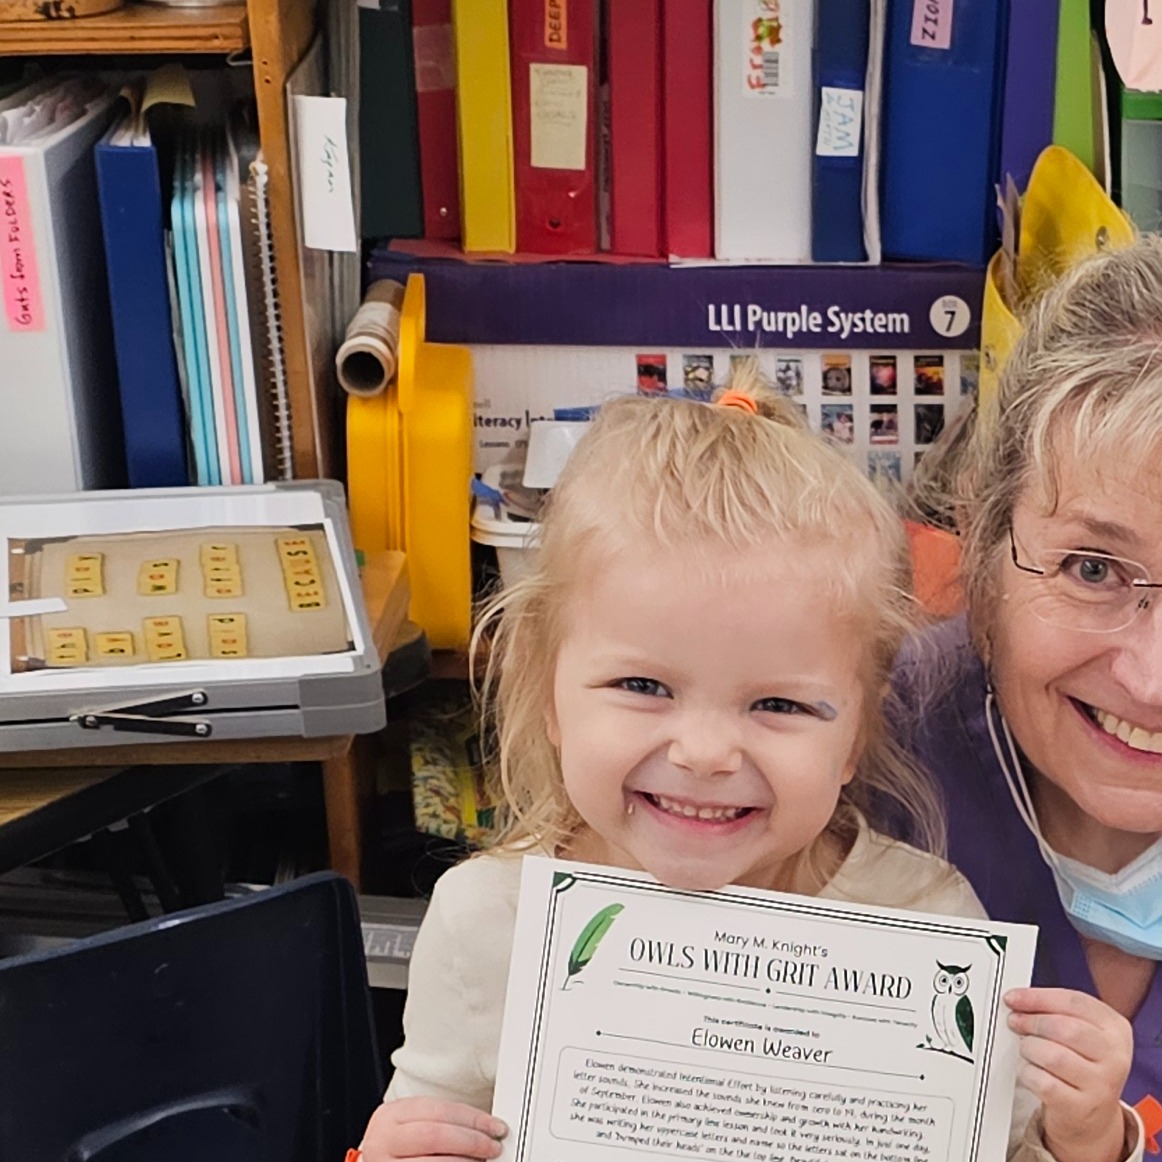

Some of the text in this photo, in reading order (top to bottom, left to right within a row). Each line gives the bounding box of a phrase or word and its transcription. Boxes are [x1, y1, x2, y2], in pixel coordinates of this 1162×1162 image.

[708, 303, 910, 340] LLI Purple System
[944, 310, 956, 332] 7
[283, 539, 321, 609] BECAUSE
[628, 937, 913, 1000] OWLS WITH GRIT AWARD
[713, 930, 829, 961] Mary M. Knight's
[691, 1026, 833, 1064] Elowen Weaver
[572, 1070, 595, 1081] letter
[634, 1079, 650, 1089] She
[652, 1082, 692, 1096] increased
[695, 1087, 709, 1099] the
[712, 1090, 742, 1103] sounds
[744, 1094, 760, 1105] she
[762, 1097, 784, 1108] knew
[787, 1100, 808, 1111] from
[832, 1107, 841, 1115] to
[859, 1109, 888, 1124] during
[890, 1113, 904, 1122] the
[908, 1114, 935, 1126] month
[579, 1084, 588, 1094] of
[641, 1093, 672, 1107] Elowen
[674, 1098, 691, 1109] also
[693, 1101, 731, 1115] achieved
[780, 1114, 796, 1123] and
[797, 1116, 829, 1130] growth
[832, 1120, 851, 1130] with
[854, 1123, 867, 1132] her
[585, 1058, 615, 1070] Elowen
[617, 1062, 676, 1079] demonstrated
[754, 1081, 767, 1095] by
[769, 1084, 806, 1100] listening
[808, 1089, 846, 1105] carefully
[850, 1095, 865, 1104] and
[867, 1097, 910, 1113] practicing
[913, 1102, 927, 1111] her
[569, 1110, 584, 1121] she
[587, 1115, 603, 1124] was
[606, 1116, 637, 1133] writing
[639, 1122, 654, 1132] her
[656, 1125, 698, 1140] uppercase
[700, 1131, 728, 1143] letters
[730, 1135, 747, 1145] and
[749, 1138, 773, 1148] name
[788, 1141, 802, 1152] the
[804, 1144, 832, 1155] letters
[849, 1150, 861, 1158] on
[863, 1150, 877, 1160] the
[570, 1097, 585, 1107] She
[588, 1100, 638, 1116] participated
[651, 1109, 665, 1120] the
[667, 1113, 702, 1127] primary
[722, 1120, 748, 1131] lesson
[751, 1124, 767, 1134] and
[799, 1131, 819, 1143] very
[895, 1142, 910, 1150] one
[595, 1129, 611, 1139] and
[652, 1136, 672, 1149] their
[705, 1145, 716, 1154] on
[718, 1146, 733, 1156] the
[735, 1148, 751, 1159] the
[752, 1150, 766, 1162] top
